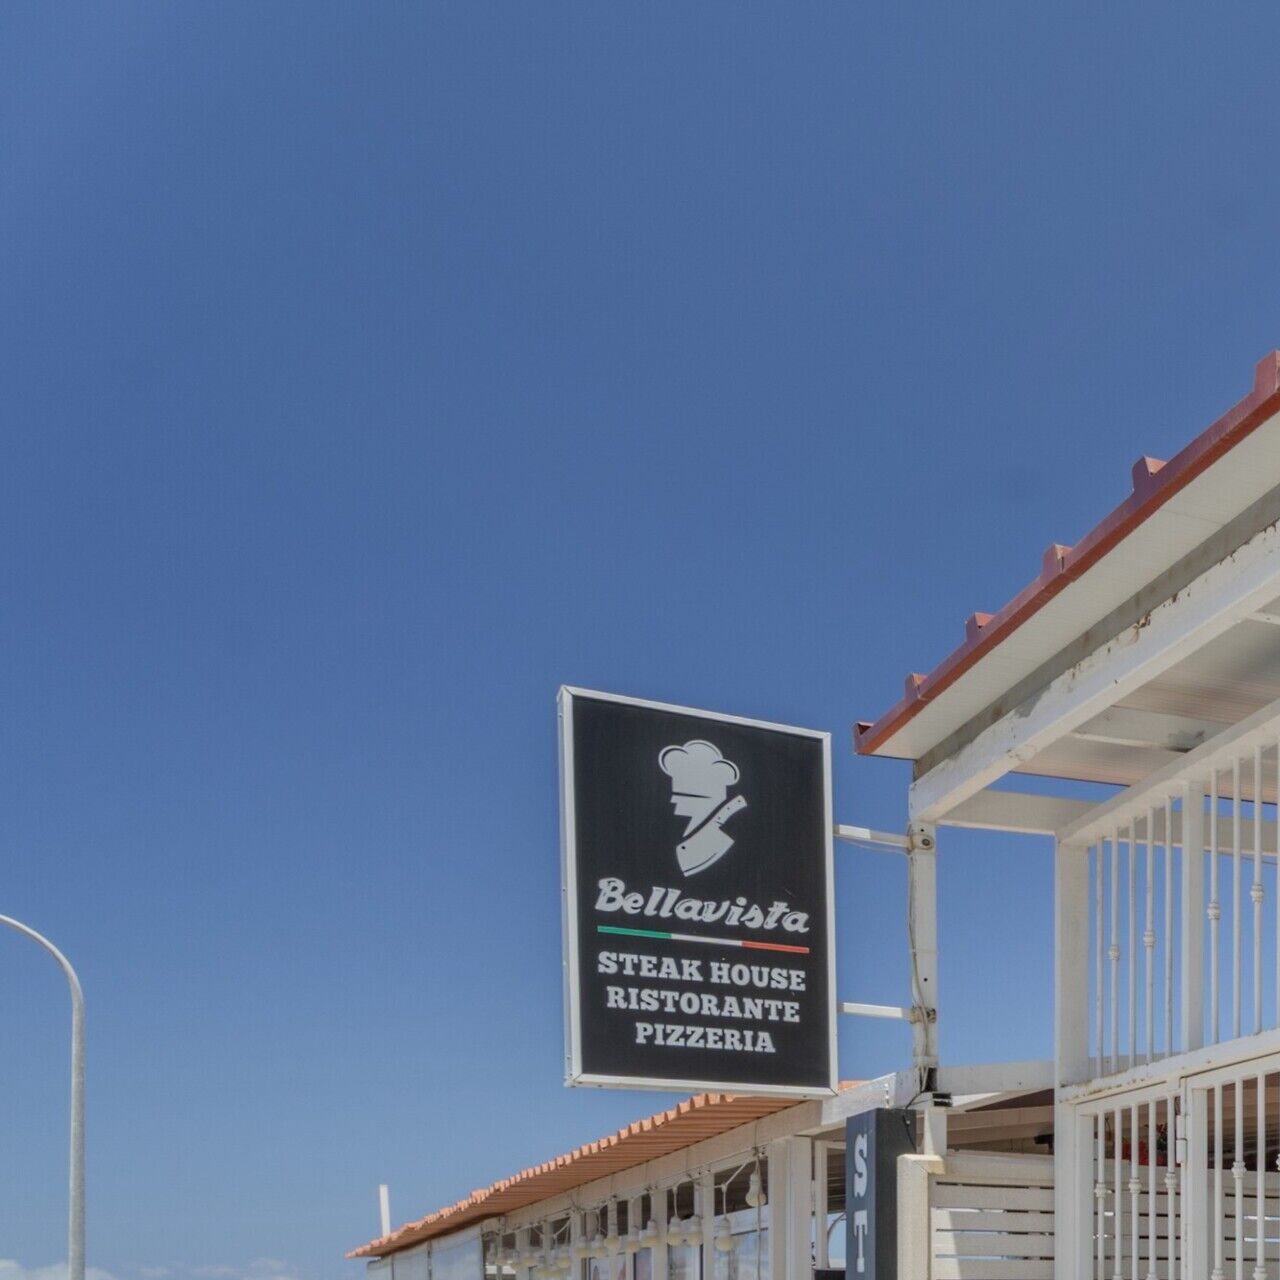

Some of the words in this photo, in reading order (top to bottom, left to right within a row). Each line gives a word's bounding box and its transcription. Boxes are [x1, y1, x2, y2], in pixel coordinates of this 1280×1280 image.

[594, 877, 810, 934] Bellavista
[597, 951, 704, 983] STEAK
[709, 961, 806, 992] HOUSE
[606, 985, 801, 1023] RISTORANTE
[635, 1021, 776, 1054] PIZZERIA
